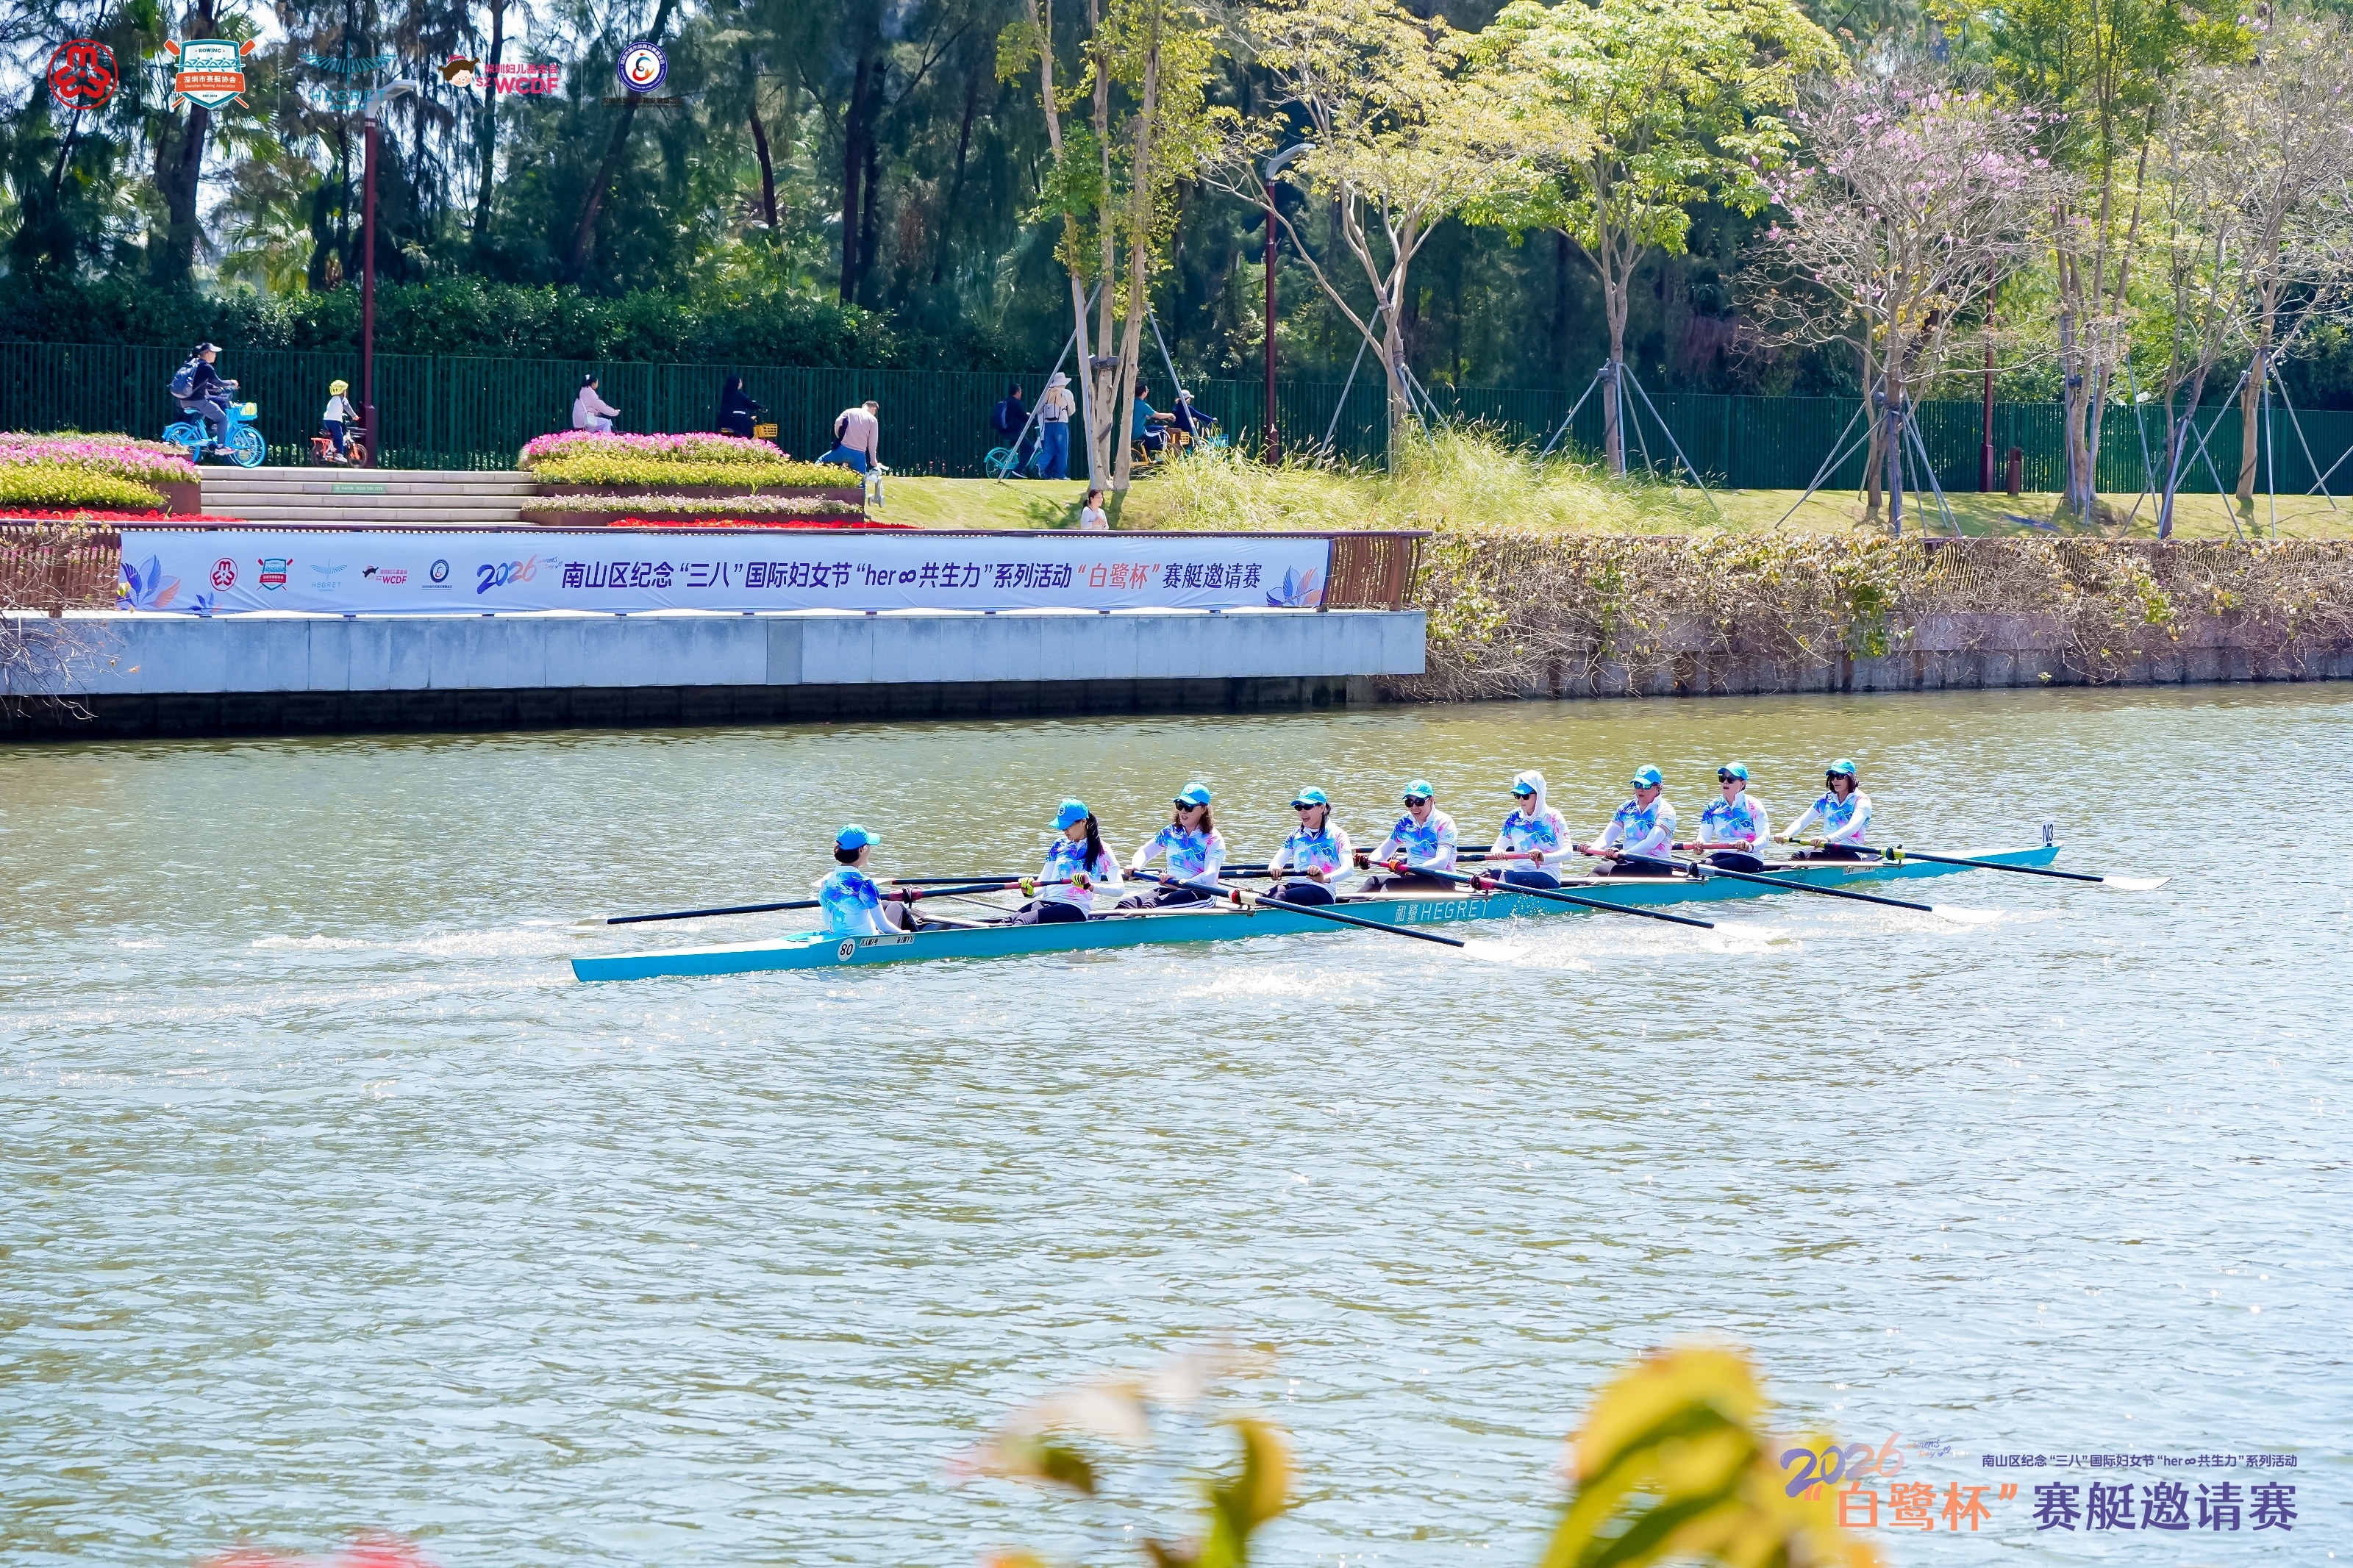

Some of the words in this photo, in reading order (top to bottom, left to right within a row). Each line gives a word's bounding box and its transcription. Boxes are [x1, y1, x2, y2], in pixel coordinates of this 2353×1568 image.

[383, 576, 407, 584] WCDF
[476, 554, 538, 595] 2026
[2043, 823, 2054, 843] N3
[1421, 899, 1490, 921] HEGRET
[840, 943, 853, 956] 80
